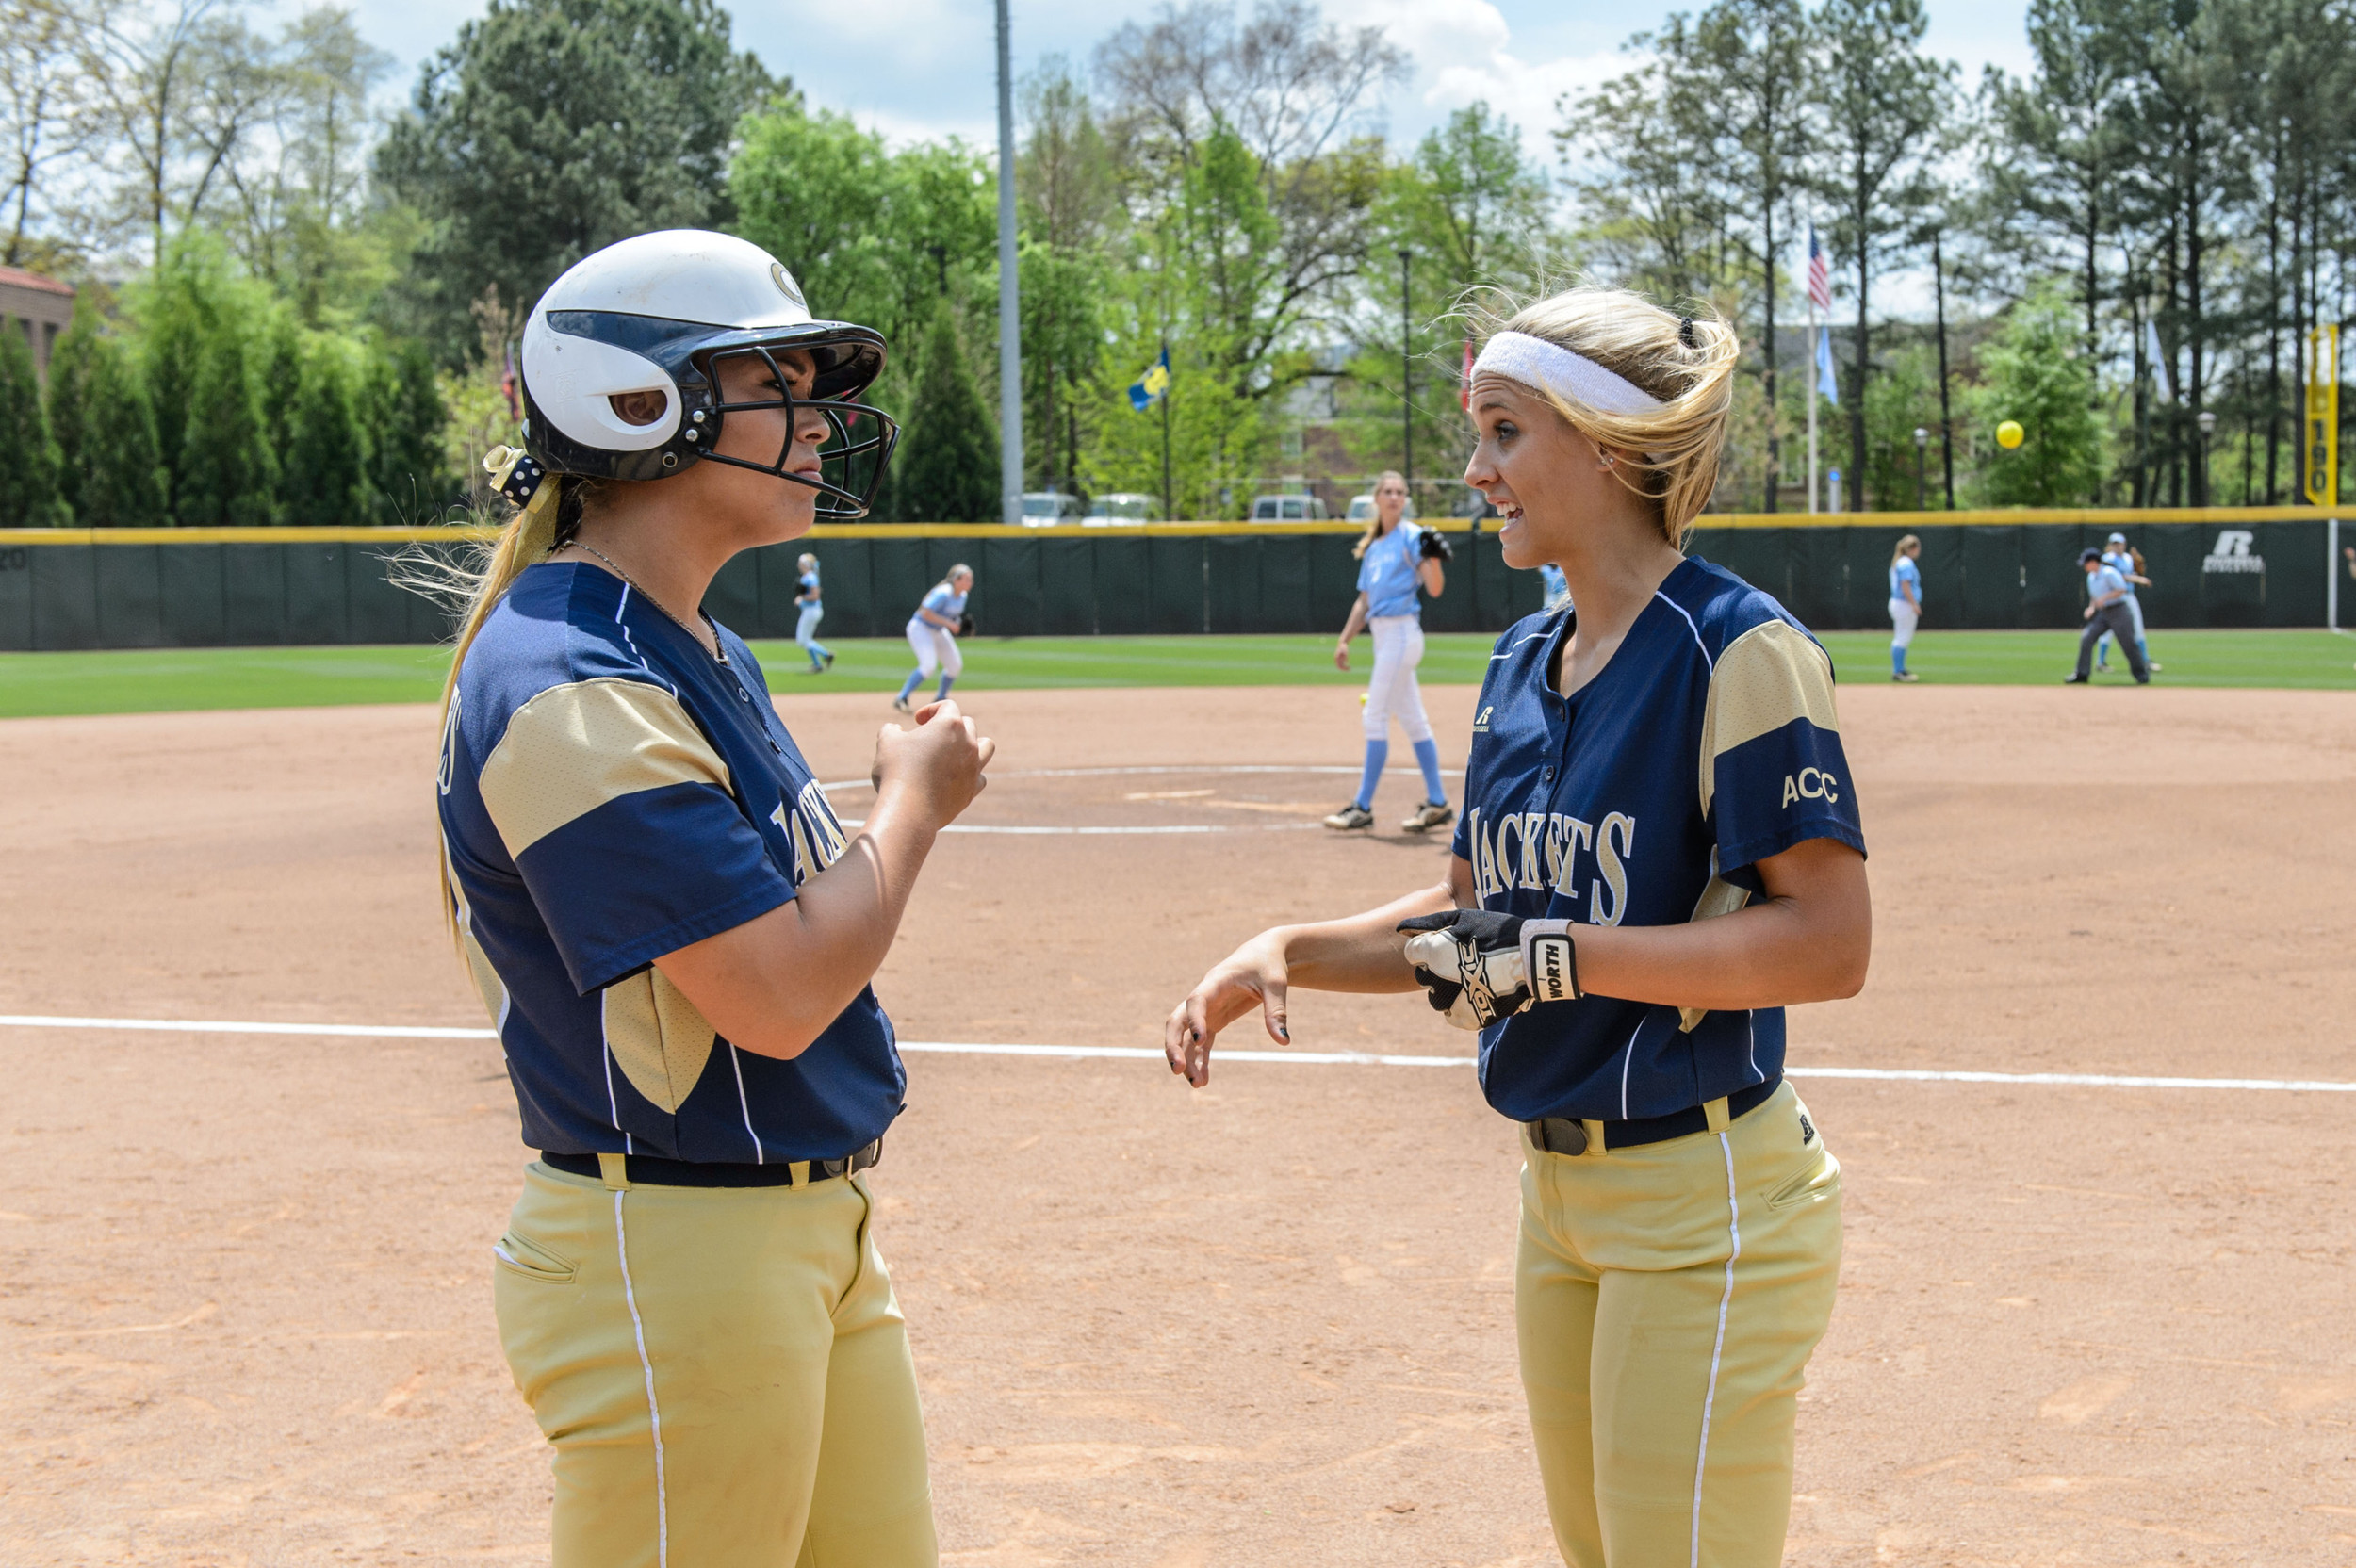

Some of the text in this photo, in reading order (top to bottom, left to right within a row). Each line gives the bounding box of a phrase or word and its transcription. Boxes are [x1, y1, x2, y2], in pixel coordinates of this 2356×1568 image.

[2312, 419, 2327, 493] 190
[1782, 767, 1838, 808] ACC
[1546, 944, 1564, 999] WORTH
